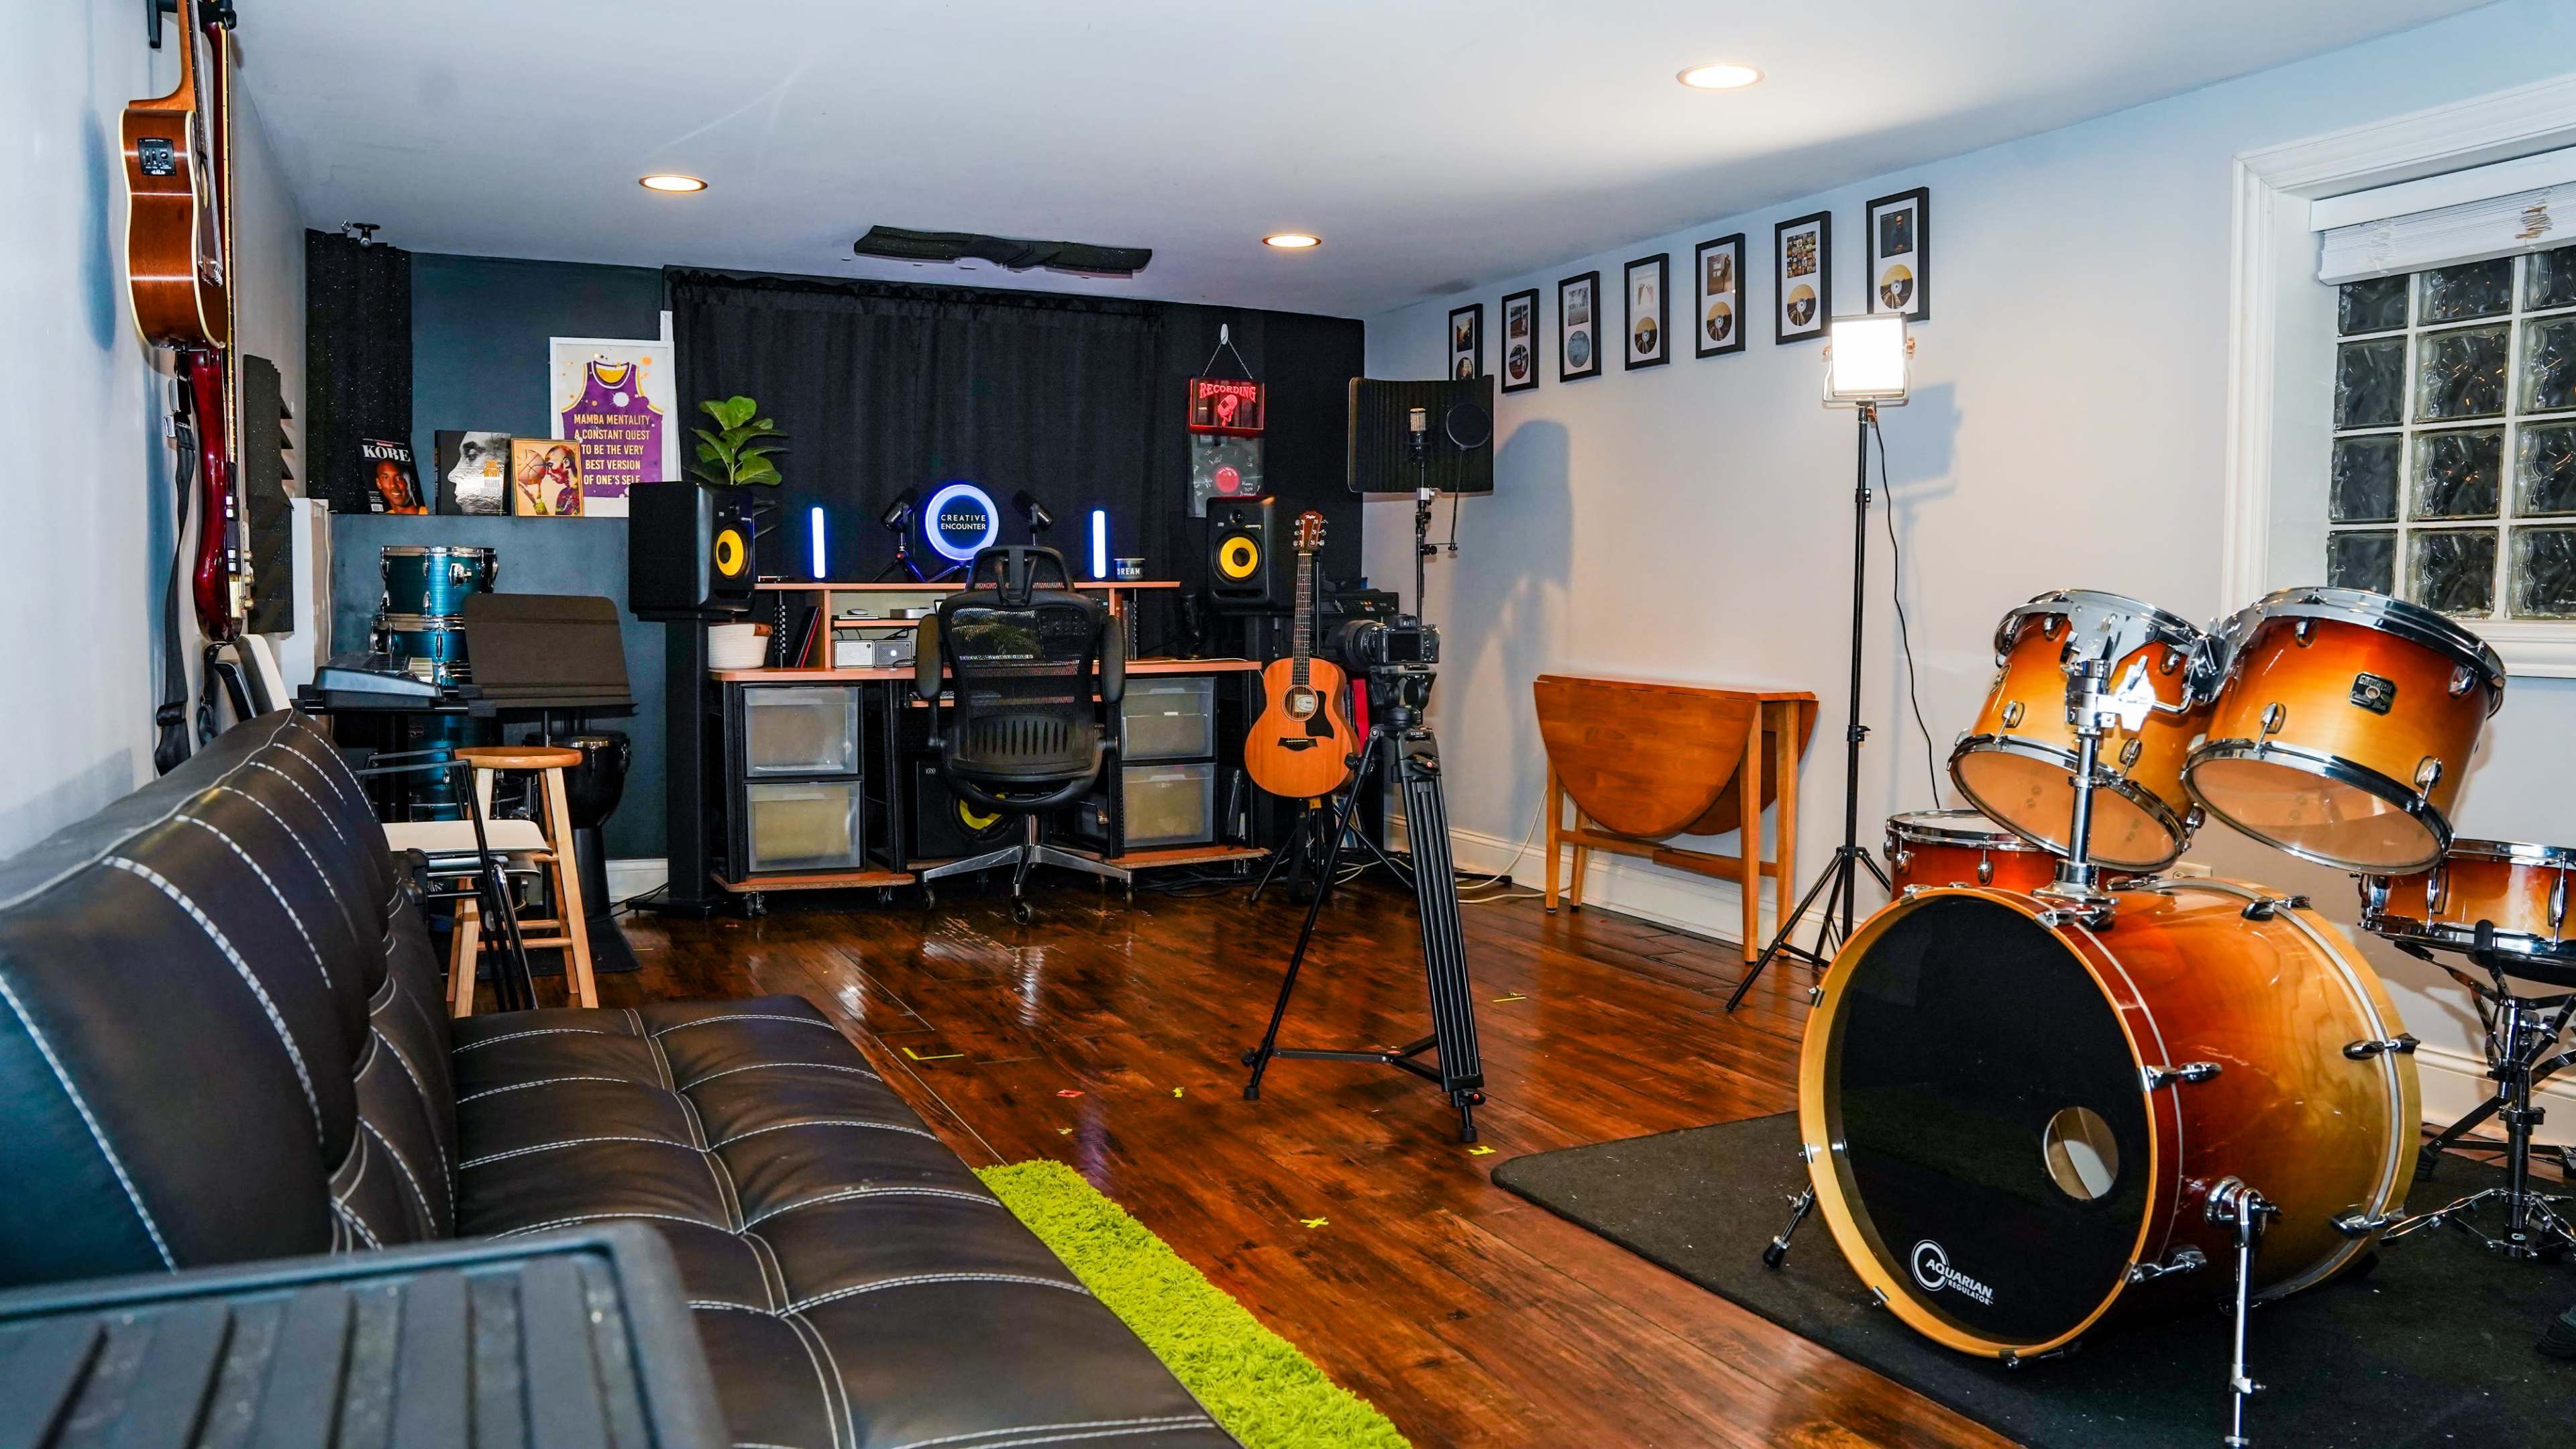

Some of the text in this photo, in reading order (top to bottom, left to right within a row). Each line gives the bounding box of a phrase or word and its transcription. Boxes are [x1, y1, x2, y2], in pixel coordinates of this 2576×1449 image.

[1199, 382, 1256, 402] RECORDING
[574, 414, 650, 425] MAMBA MENTALITY
[574, 429, 650, 440] A CONSTANT QUEST
[362, 444, 411, 462] KOBE
[581, 444, 644, 455] TO BE THE VERY
[585, 460, 641, 470] BEST VERSION
[584, 474, 594, 485] OF
[596, 475, 620, 485] ONE'S
[1117, 568, 1140, 576] DREAM
[1925, 1258, 1993, 1299] AQUARIAN
[1948, 1281, 1990, 1305] REGULATOR
